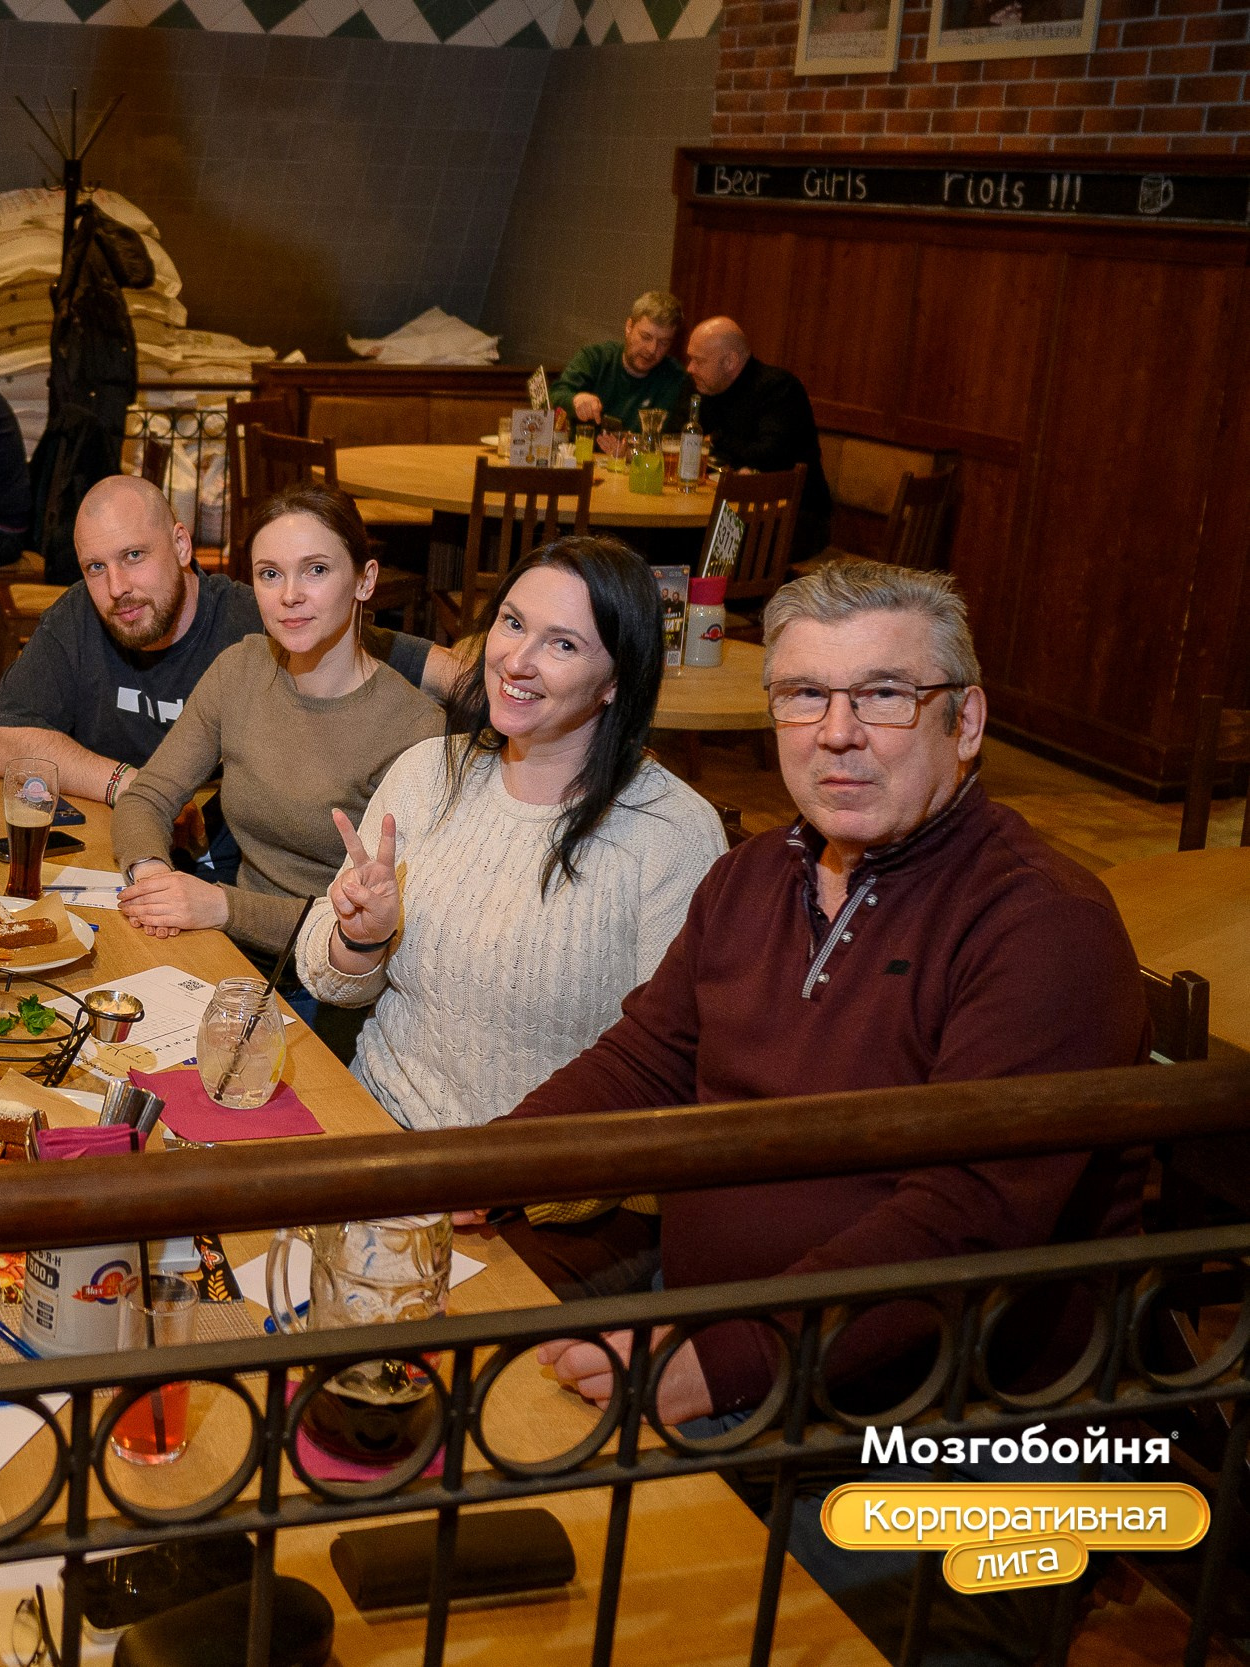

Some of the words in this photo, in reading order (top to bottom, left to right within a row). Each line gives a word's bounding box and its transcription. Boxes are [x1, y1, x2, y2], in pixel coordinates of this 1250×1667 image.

[714, 167, 770, 196] Beer
[803, 168, 868, 200] Girls
[943, 171, 1026, 209] riots
[719, 526, 735, 555] 311
